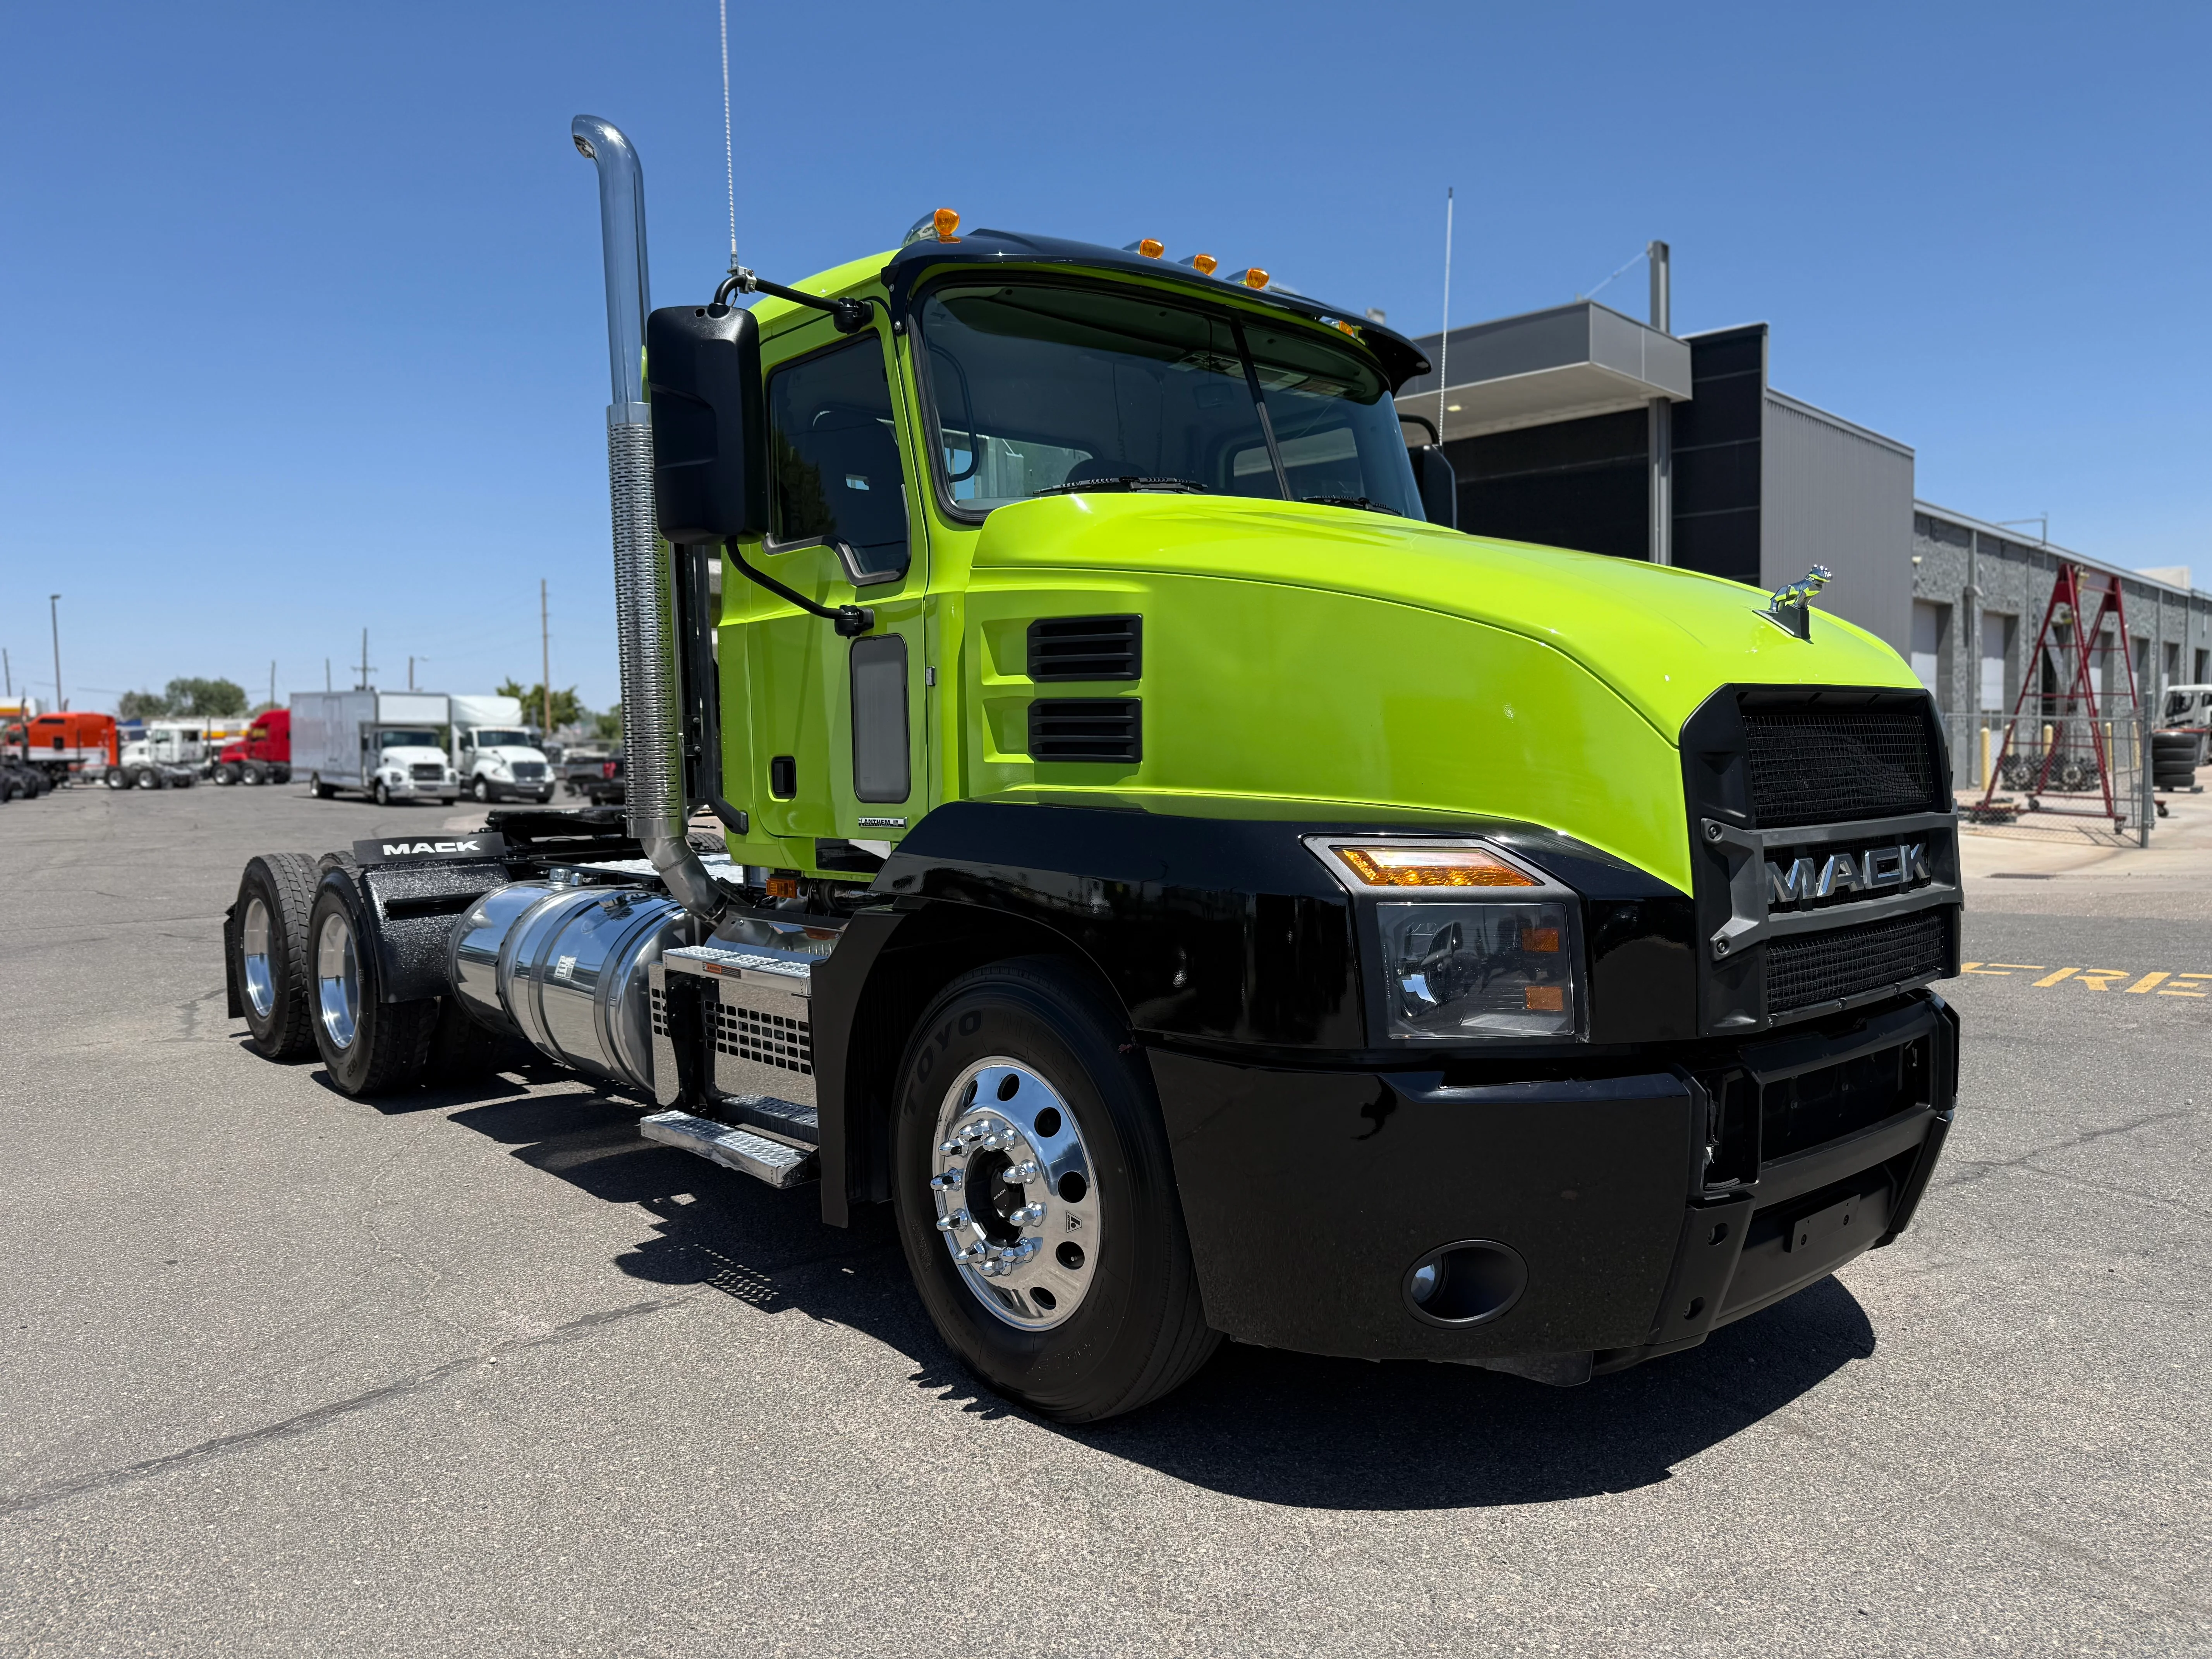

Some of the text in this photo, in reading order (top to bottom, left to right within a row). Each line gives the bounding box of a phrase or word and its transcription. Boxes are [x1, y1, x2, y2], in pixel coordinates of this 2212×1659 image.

[383, 840, 480, 855] MACK
[1764, 843, 1931, 904] MACK
[903, 1009, 983, 1116] TOYO
[994, 1188, 1006, 1200] MACK
